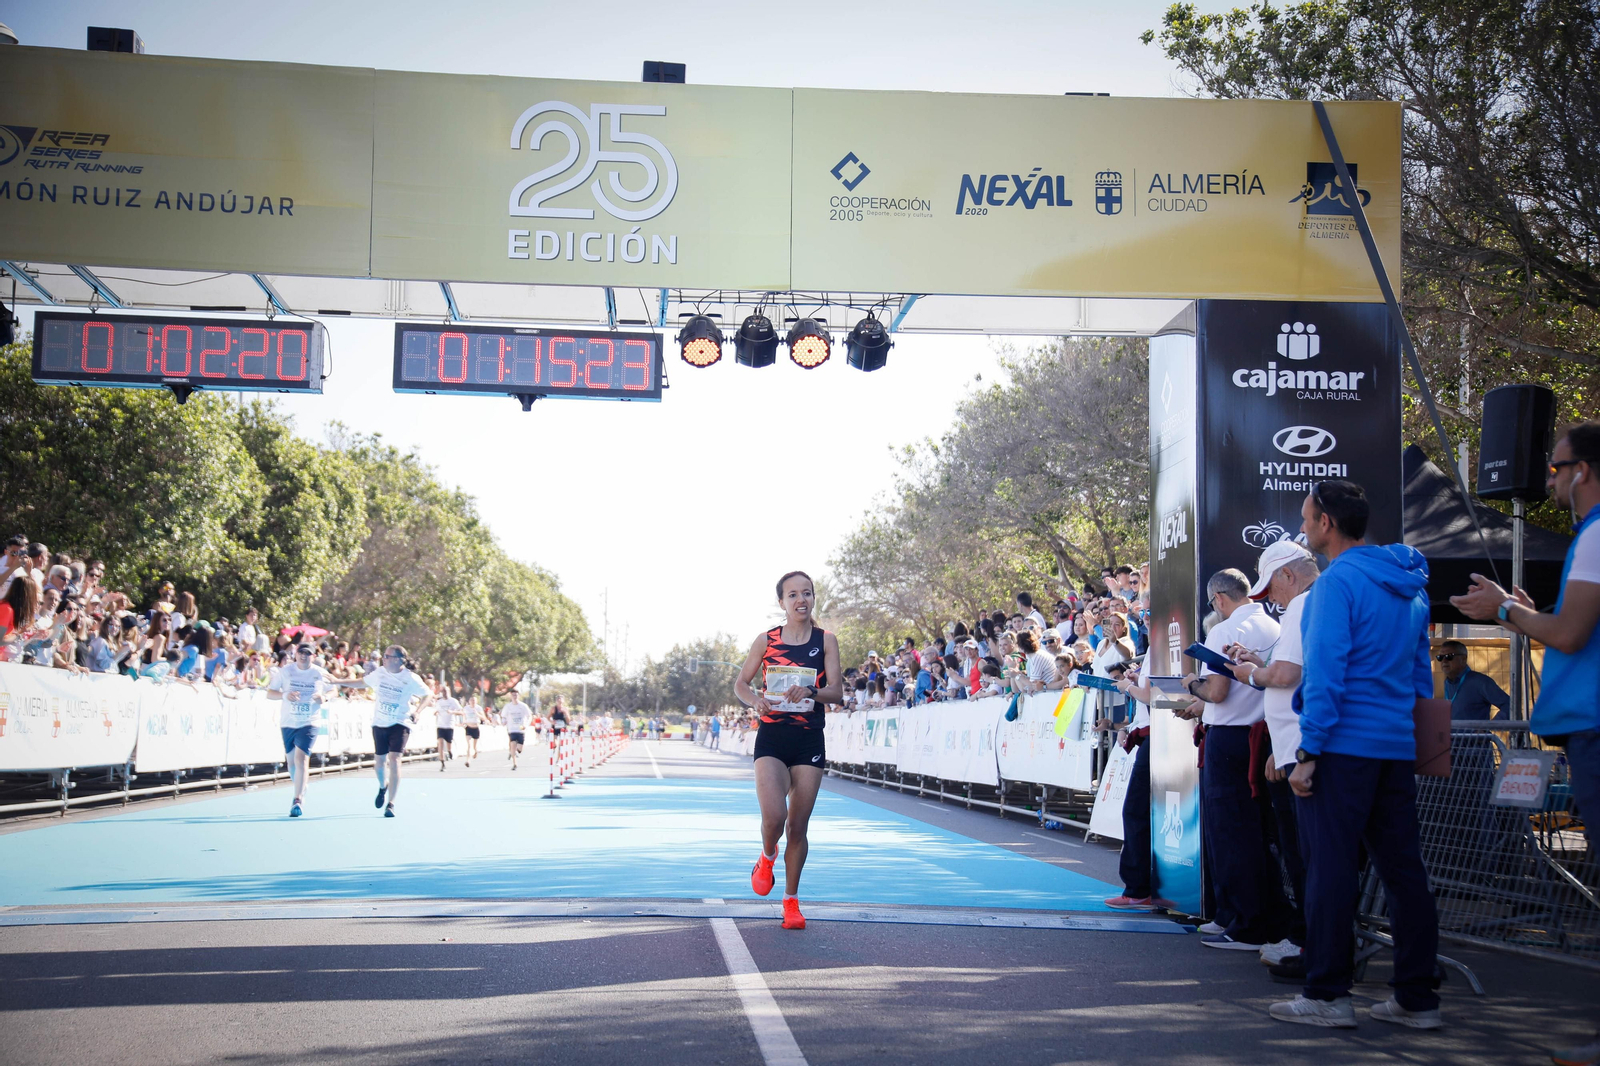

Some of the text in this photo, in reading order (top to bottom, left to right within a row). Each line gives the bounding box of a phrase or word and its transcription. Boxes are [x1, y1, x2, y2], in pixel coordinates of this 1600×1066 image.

[38, 130, 111, 147] RFEA
[30, 146, 103, 161] SERIES
[509, 100, 679, 222] 25
[23, 158, 144, 174] RUTA RUNNING
[1148, 169, 1266, 195] ALMERÍA
[72, 185, 141, 208] RUIZ
[154, 190, 294, 216] ANDÚJAR
[830, 196, 931, 211] COOPERACIÓN
[1147, 198, 1208, 212] CIUDAD
[829, 209, 864, 221] 2005
[965, 208, 988, 216] 2020
[1298, 222, 1346, 231] DEPORTES
[508, 226, 678, 264] EDICIÓN
[1232, 361, 1365, 397] cajamar
[1296, 391, 1362, 401] CAJA RURAL
[1260, 462, 1347, 477] HYUNDAI
